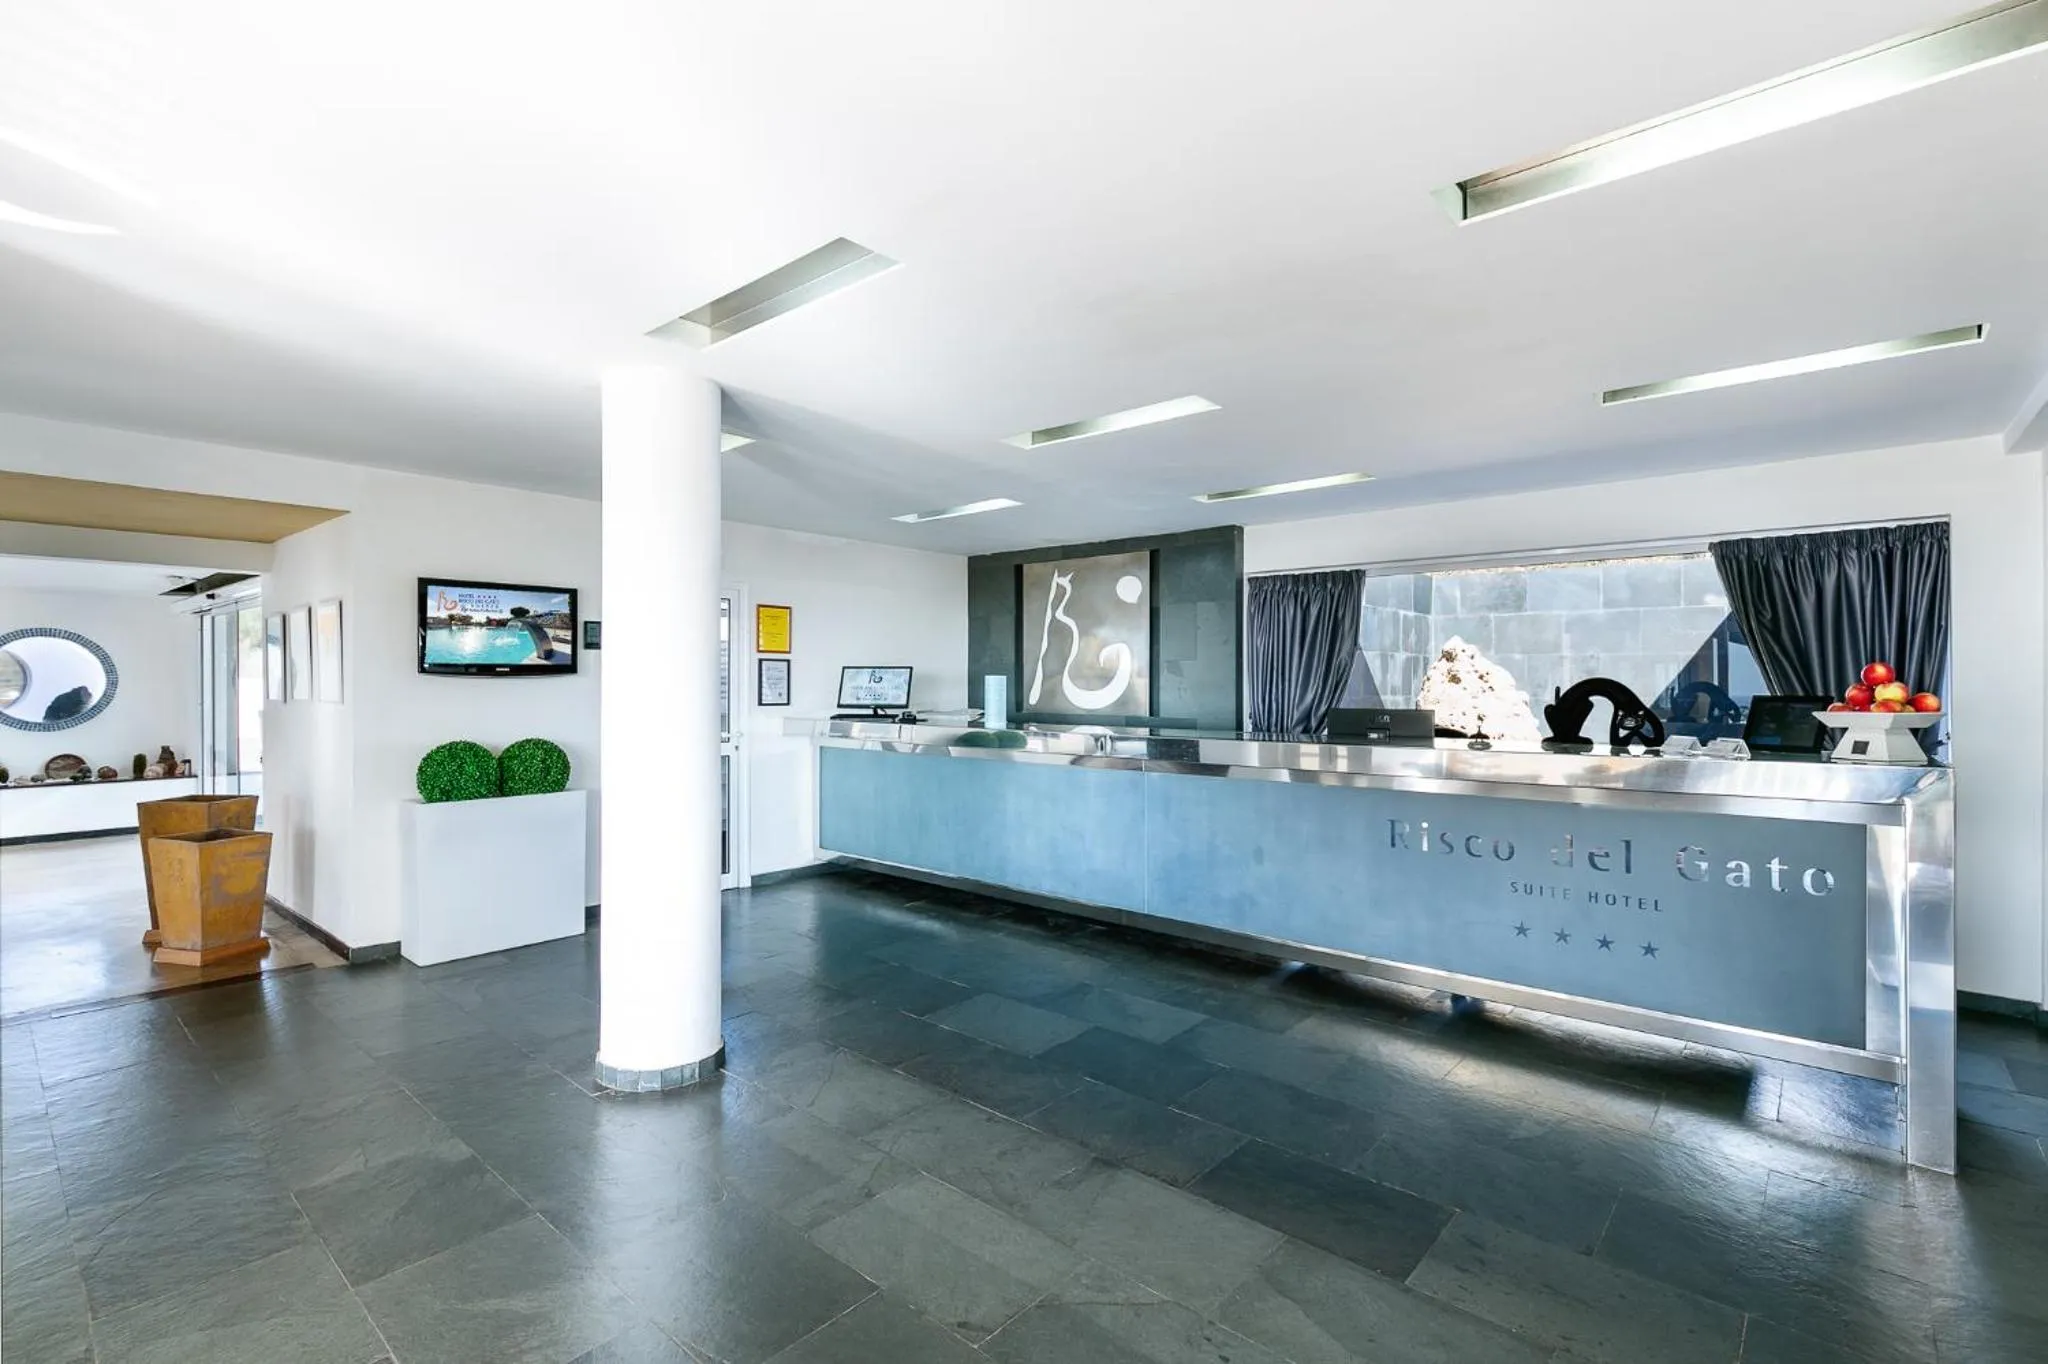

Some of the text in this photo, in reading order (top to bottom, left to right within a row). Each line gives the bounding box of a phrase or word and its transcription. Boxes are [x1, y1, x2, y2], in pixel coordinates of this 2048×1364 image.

[1387, 819, 1835, 896] Risco del Gato
[1510, 880, 1663, 912] SUITE HOTEL
